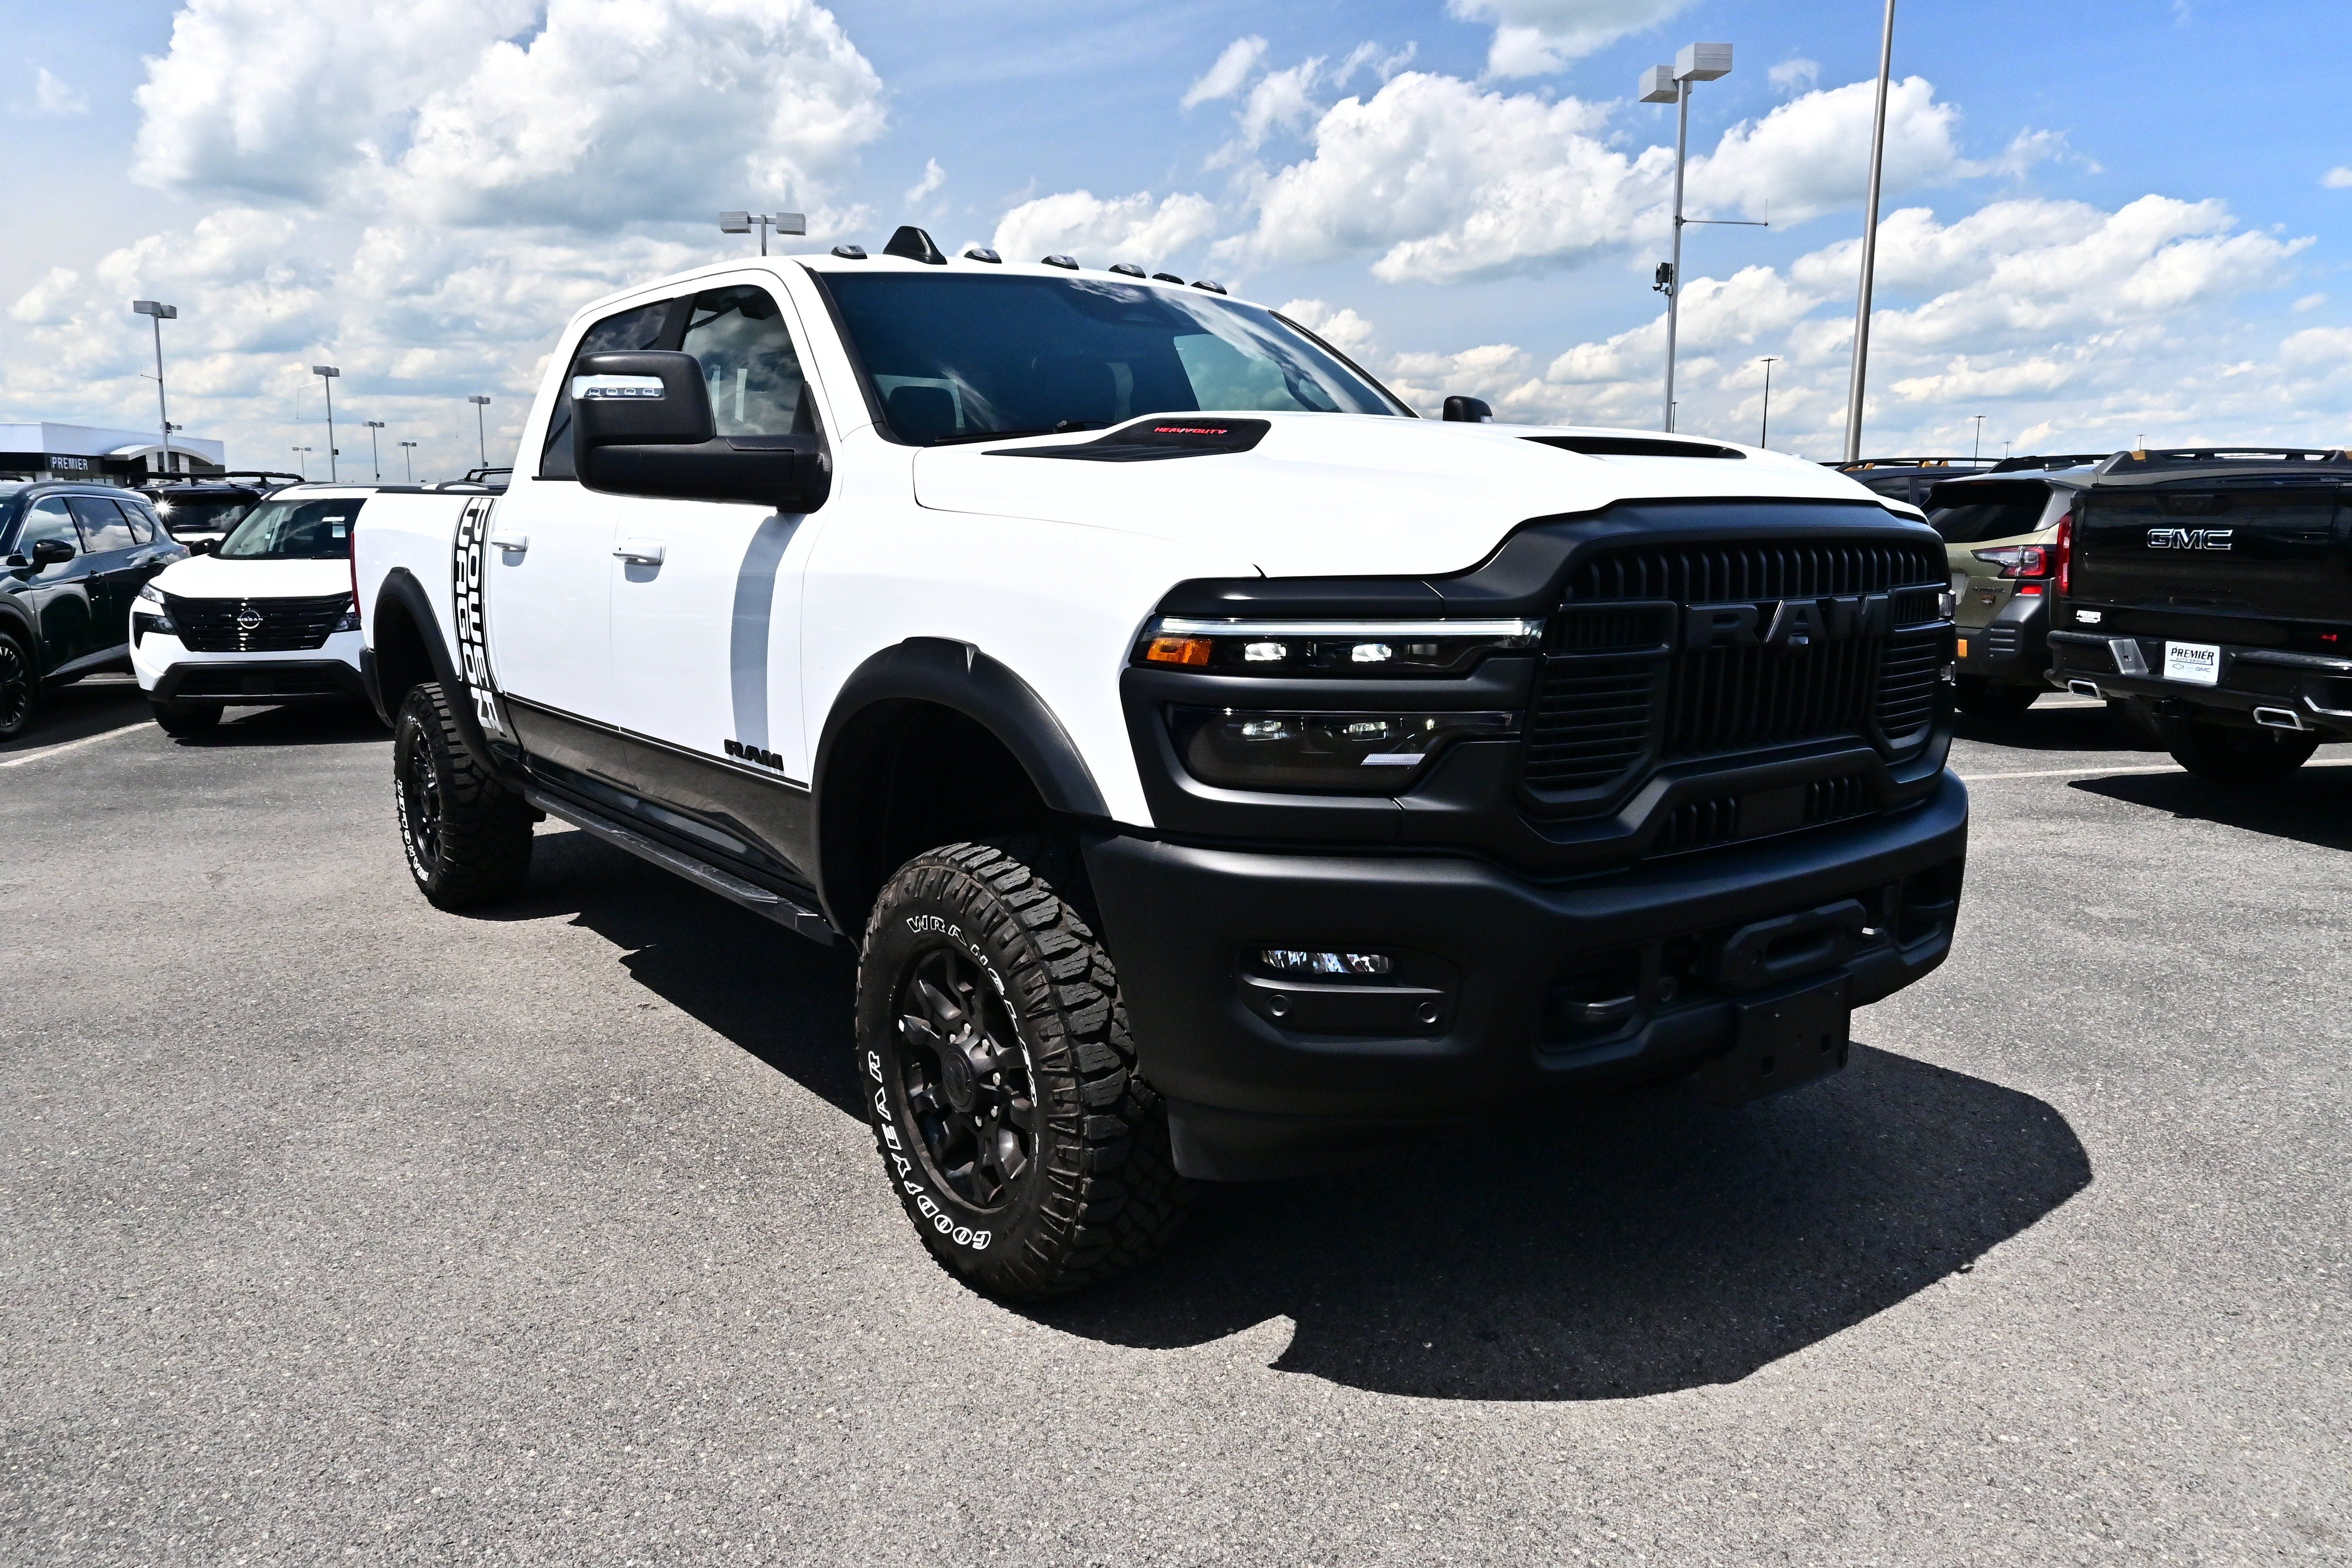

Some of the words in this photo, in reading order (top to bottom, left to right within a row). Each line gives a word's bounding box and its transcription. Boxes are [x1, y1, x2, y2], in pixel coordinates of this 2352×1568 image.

[50, 457, 88, 470] PREMIER
[2147, 528, 2233, 550] GMC
[456, 498, 493, 728] WAGON
[468, 498, 503, 732] POWER
[1685, 593, 1890, 650] RAM
[2171, 648, 2214, 661] PREMIER
[724, 739, 784, 771] RAM
[906, 915, 1037, 1108] WRANGLER
[868, 1051, 992, 1250] GOODYEAR
